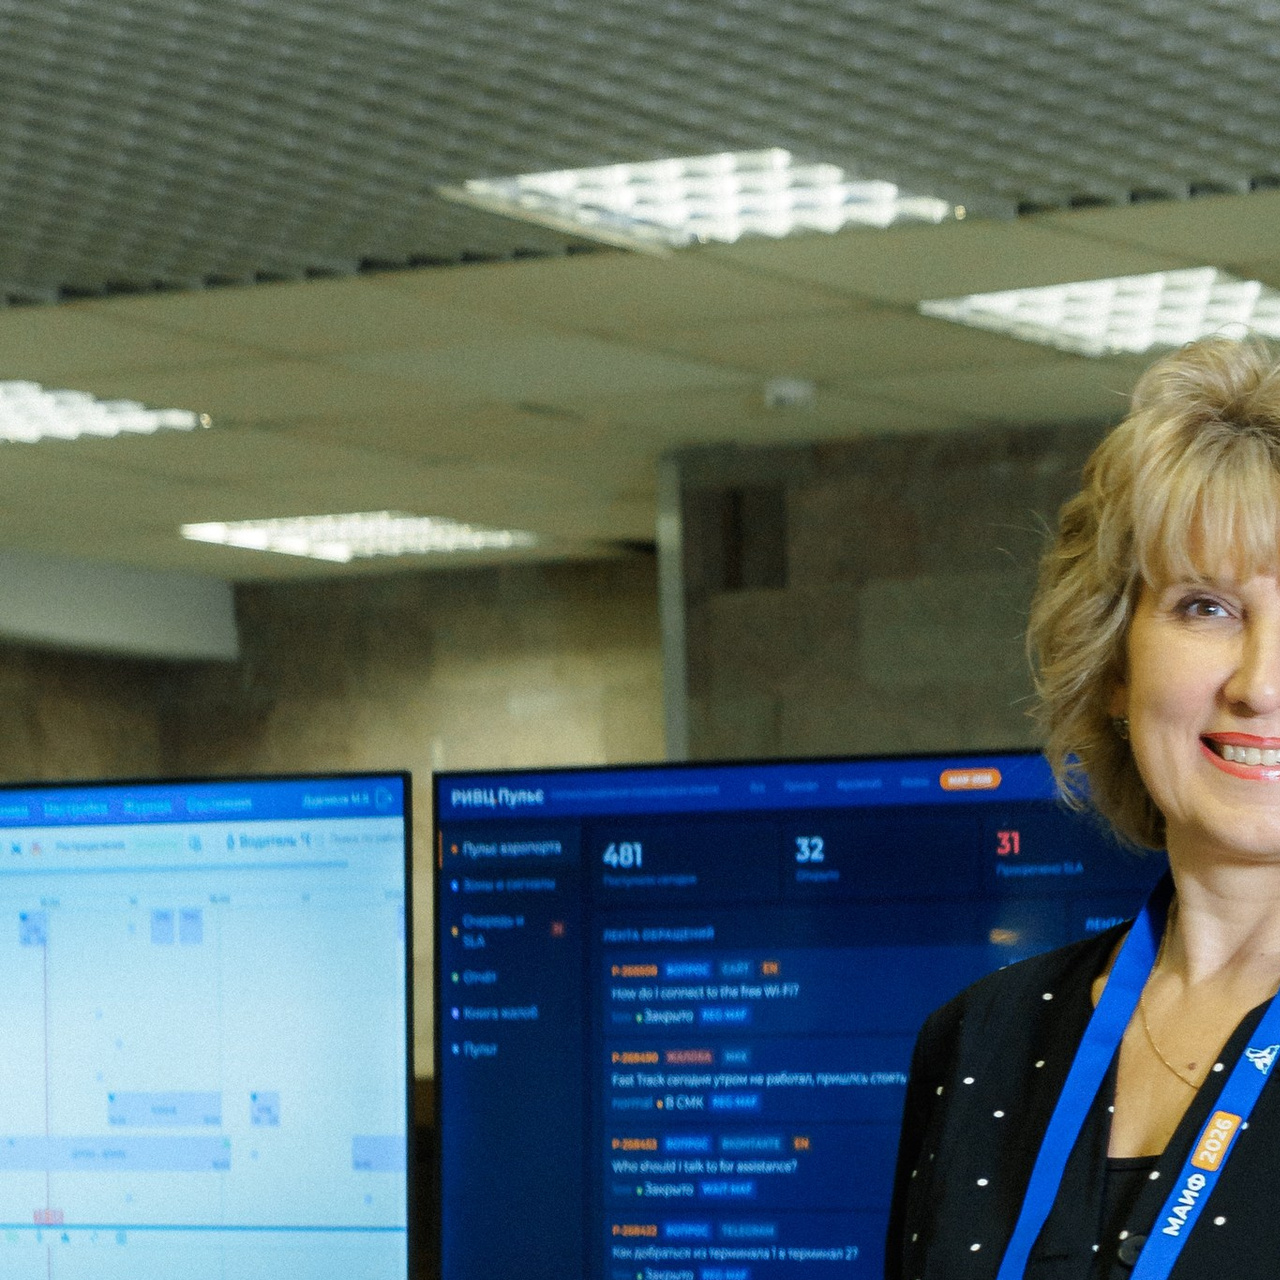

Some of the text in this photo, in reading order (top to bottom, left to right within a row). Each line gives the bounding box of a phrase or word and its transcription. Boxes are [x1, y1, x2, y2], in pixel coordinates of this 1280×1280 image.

[603, 842, 642, 868] 481
[796, 836, 824, 862] 32
[997, 831, 1020, 855] 31
[1200, 1116, 1233, 1165] 2026
[1162, 1172, 1207, 1236] МАИФ
